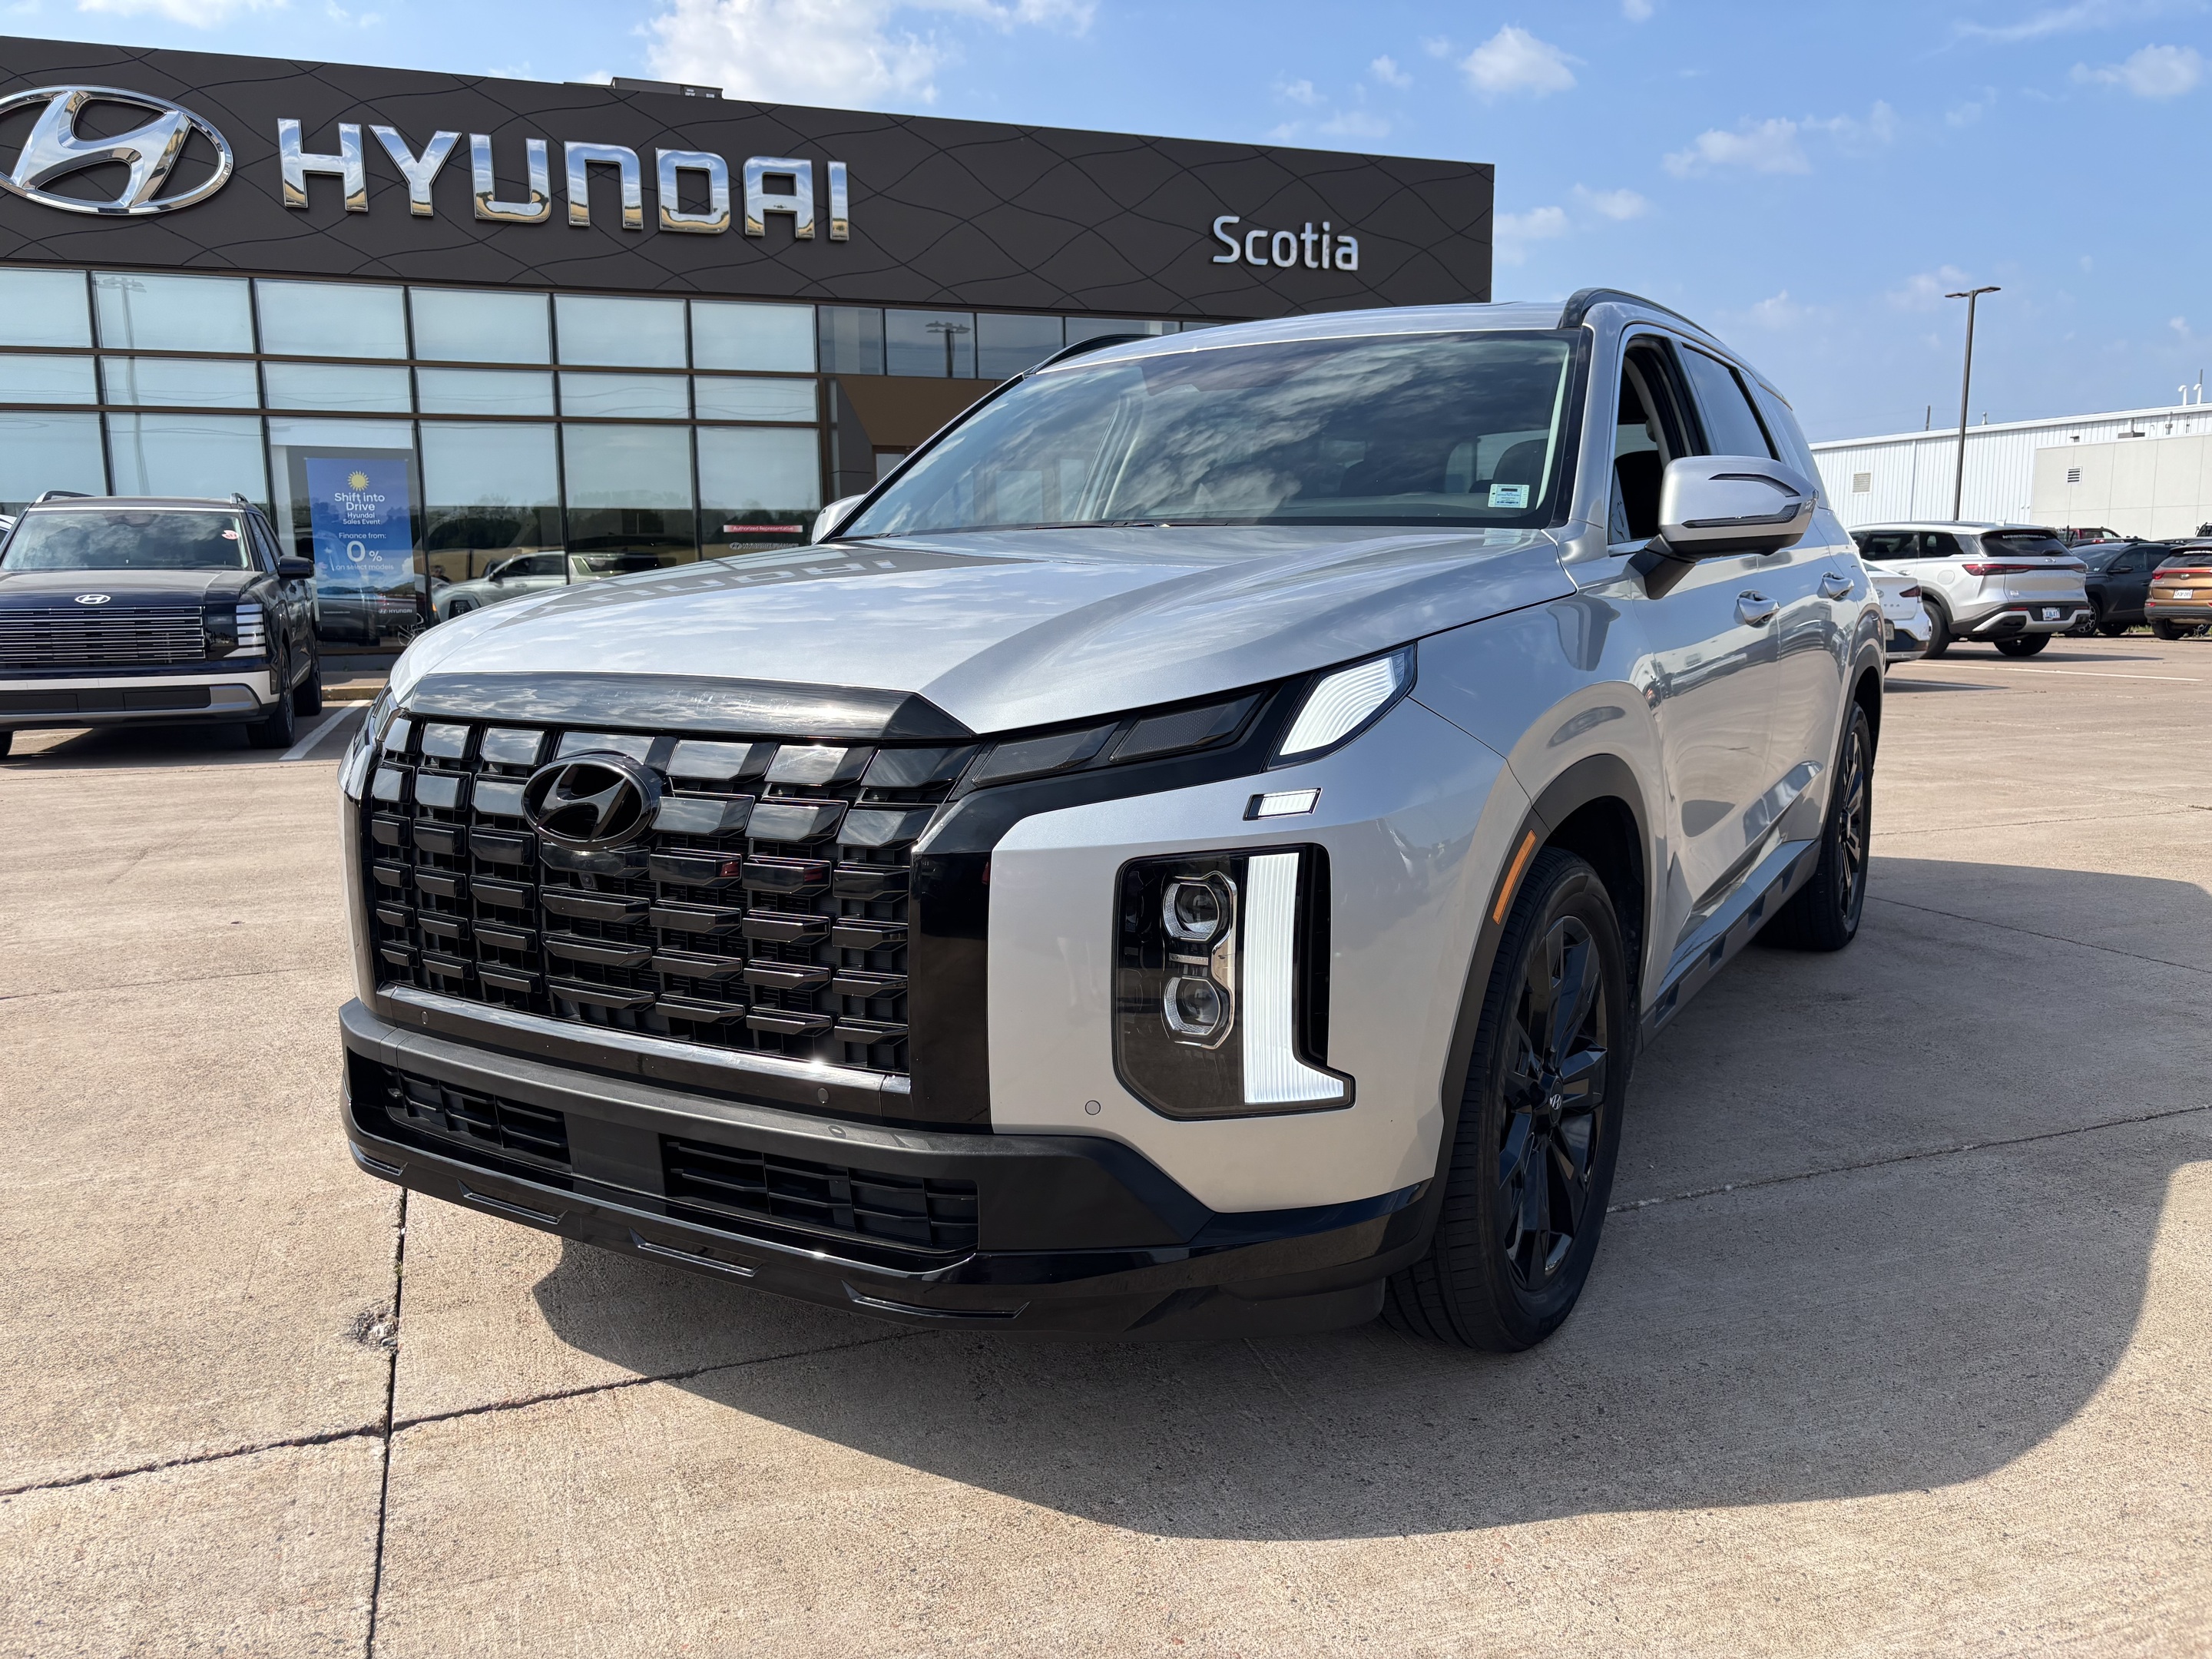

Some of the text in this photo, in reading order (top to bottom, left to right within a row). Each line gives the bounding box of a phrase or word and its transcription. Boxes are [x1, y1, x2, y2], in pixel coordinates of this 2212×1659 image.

[277, 117, 849, 241] HYUNDAI
[1212, 215, 1359, 271] Scotia
[334, 492, 386, 502] Shift into
[346, 502, 376, 511] Drive
